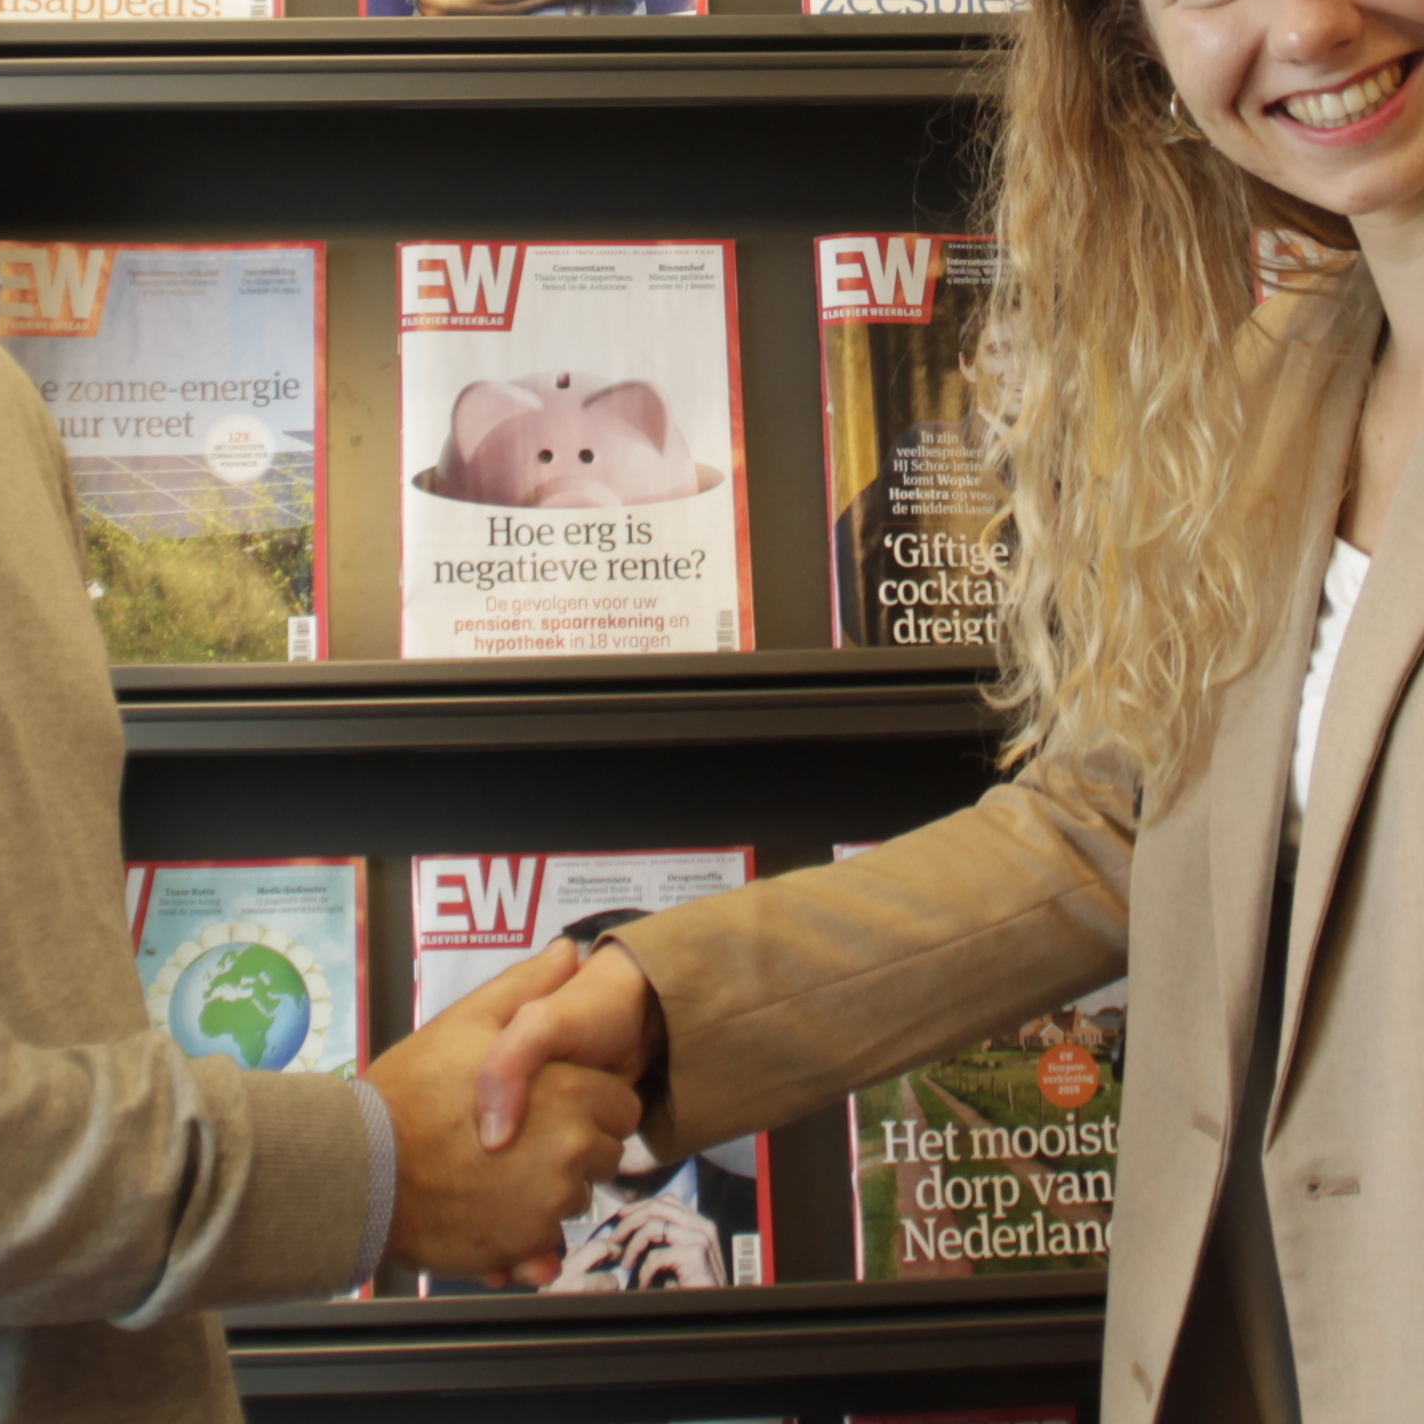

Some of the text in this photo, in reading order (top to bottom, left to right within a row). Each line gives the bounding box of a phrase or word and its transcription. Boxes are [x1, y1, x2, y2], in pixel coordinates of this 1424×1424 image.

[401, 245, 517, 314] EW
[821, 236, 931, 307] EW
[67, 372, 300, 407] zonne-energie
[112, 413, 194, 438] vreet
[487, 515, 652, 552] Hoe erg is
[433, 550, 706, 591] negatieve rente?
[455, 614, 689, 634] pensioen, spaarrekening en
[486, 596, 657, 615] De gevolgen voor uw
[474, 634, 670, 653] hypotheek in 18 vragen
[420, 857, 537, 931] EW
[882, 1118, 960, 1164] Het
[916, 1166, 1112, 1217] dorp van
